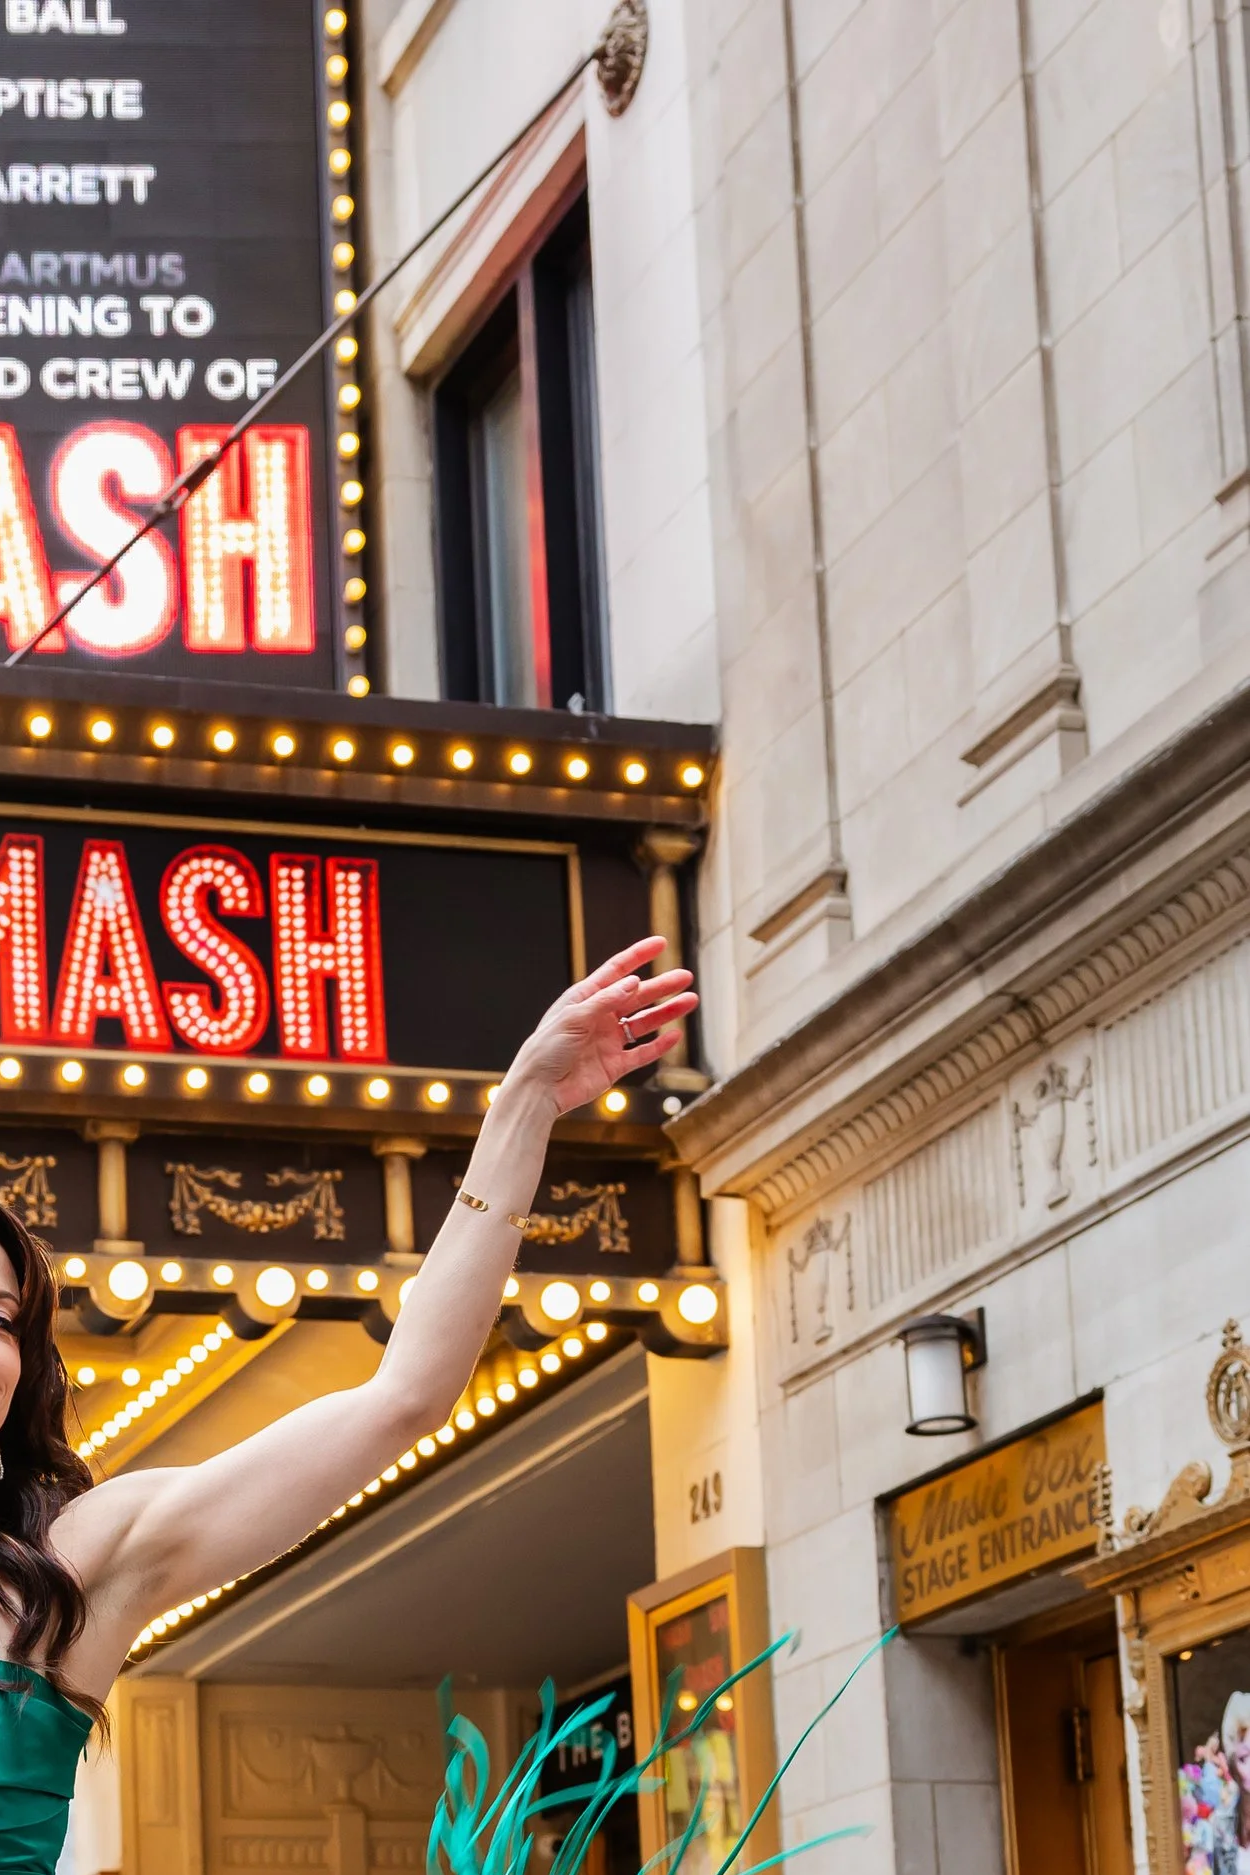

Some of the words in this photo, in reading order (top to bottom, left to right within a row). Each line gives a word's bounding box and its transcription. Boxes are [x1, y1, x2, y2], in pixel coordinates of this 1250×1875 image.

[5, 0, 127, 34] BALL
[140, 295, 214, 337] TO
[40, 358, 195, 400] CREW
[205, 359, 280, 401] OF
[901, 1464, 1007, 1558] Music
[1022, 1434, 1095, 1505] Box
[903, 1544, 970, 1604] STAGE
[977, 1488, 1099, 1573] ENTRANCE
